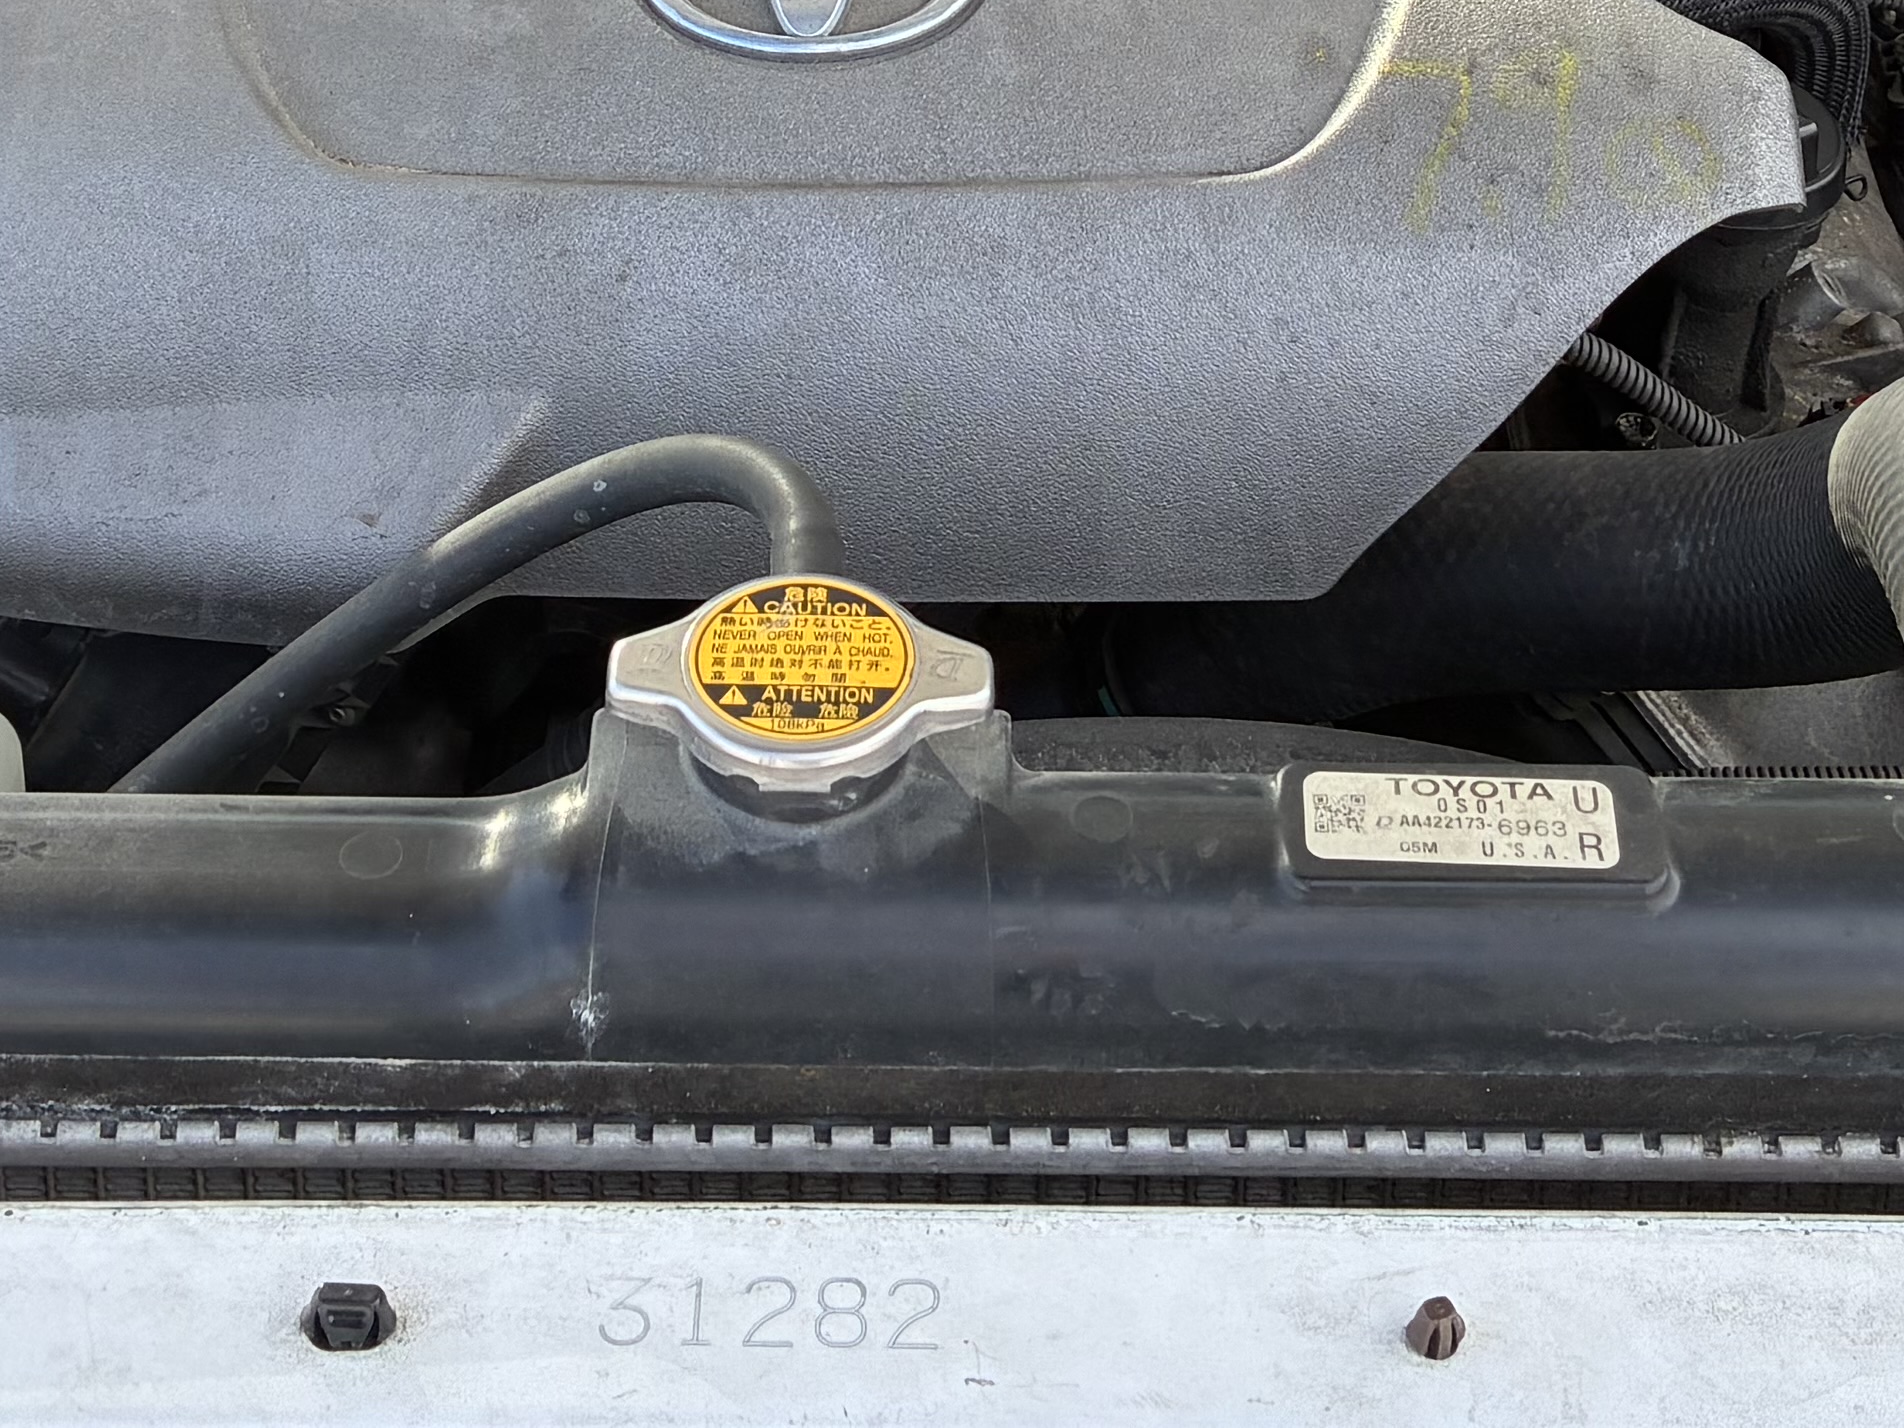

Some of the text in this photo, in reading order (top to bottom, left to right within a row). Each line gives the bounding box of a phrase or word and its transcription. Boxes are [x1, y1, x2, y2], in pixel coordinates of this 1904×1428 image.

[763, 600, 867, 616] CAUTION
[712, 628, 894, 645] NEVER OPEN WHEN HOT.
[710, 642, 728, 654] NE
[732, 643, 778, 656] JAMAIS
[782, 643, 827, 657] OUVRIR
[848, 646, 894, 659] CHAUD.
[761, 686, 875, 704] ATTENTION
[1384, 776, 1601, 815] TOYOTA U
[1577, 831, 1606, 863] R
[597, 1275, 941, 1350] 31282
